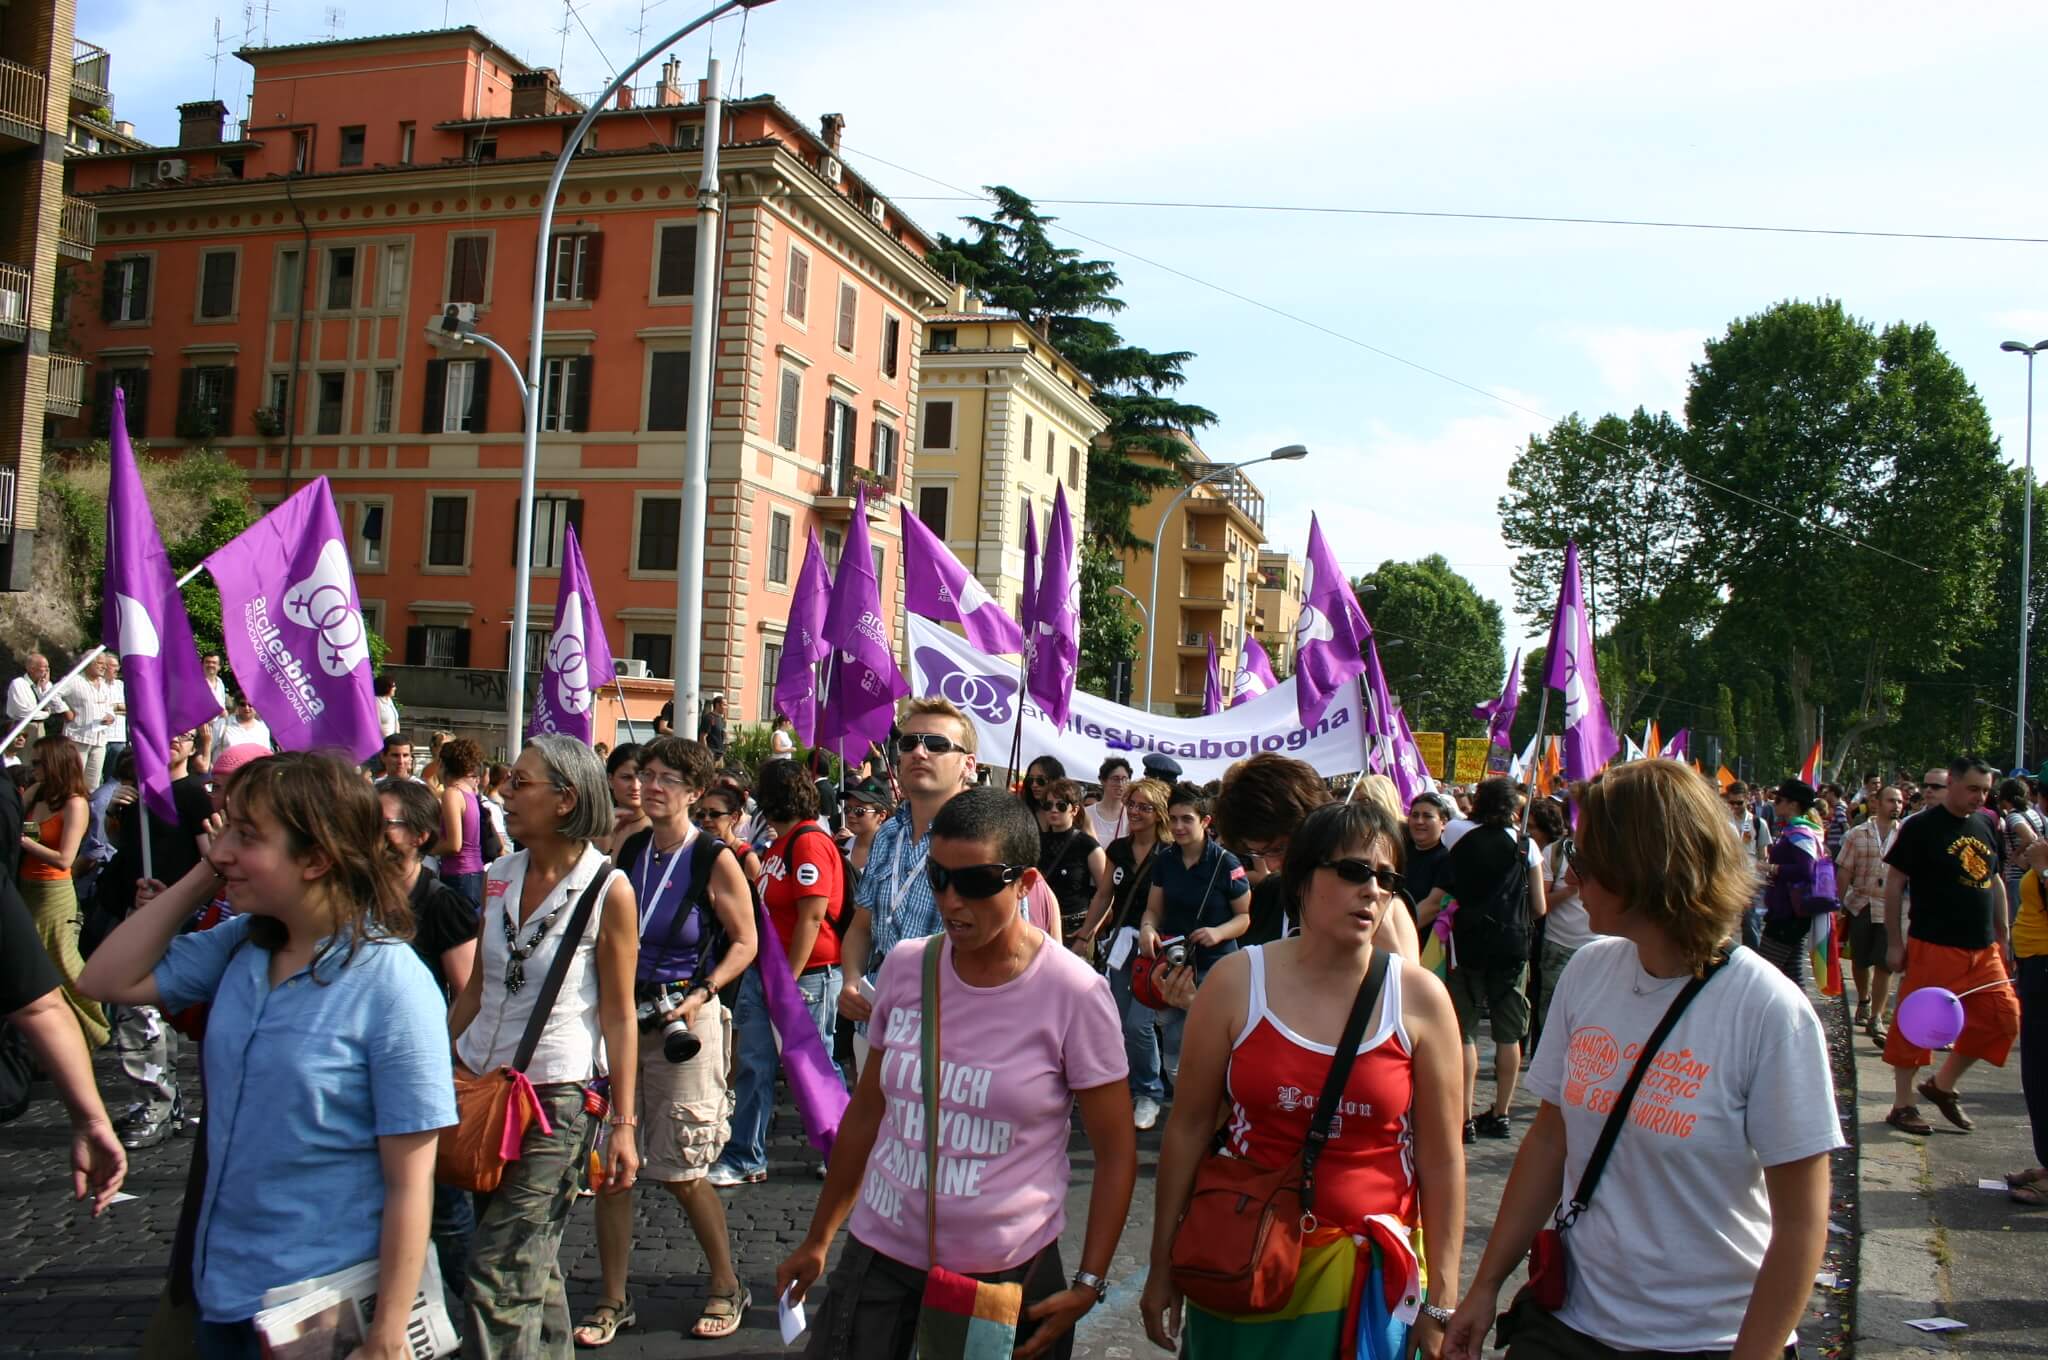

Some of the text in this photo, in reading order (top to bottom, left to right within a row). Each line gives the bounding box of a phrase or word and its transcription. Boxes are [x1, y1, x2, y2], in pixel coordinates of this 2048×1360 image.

[244, 603, 312, 724] ASSOCIAZIONE NAZIONALE
[254, 596, 325, 716] arcilesbica
[1021, 703, 1350, 759] arilesbicabologna
[1623, 1043, 1711, 1080] CADIAN
[1277, 1086, 1372, 1117] Loon
[937, 1110, 1011, 1155] YOUR
[864, 1168, 905, 1227] SIDE
